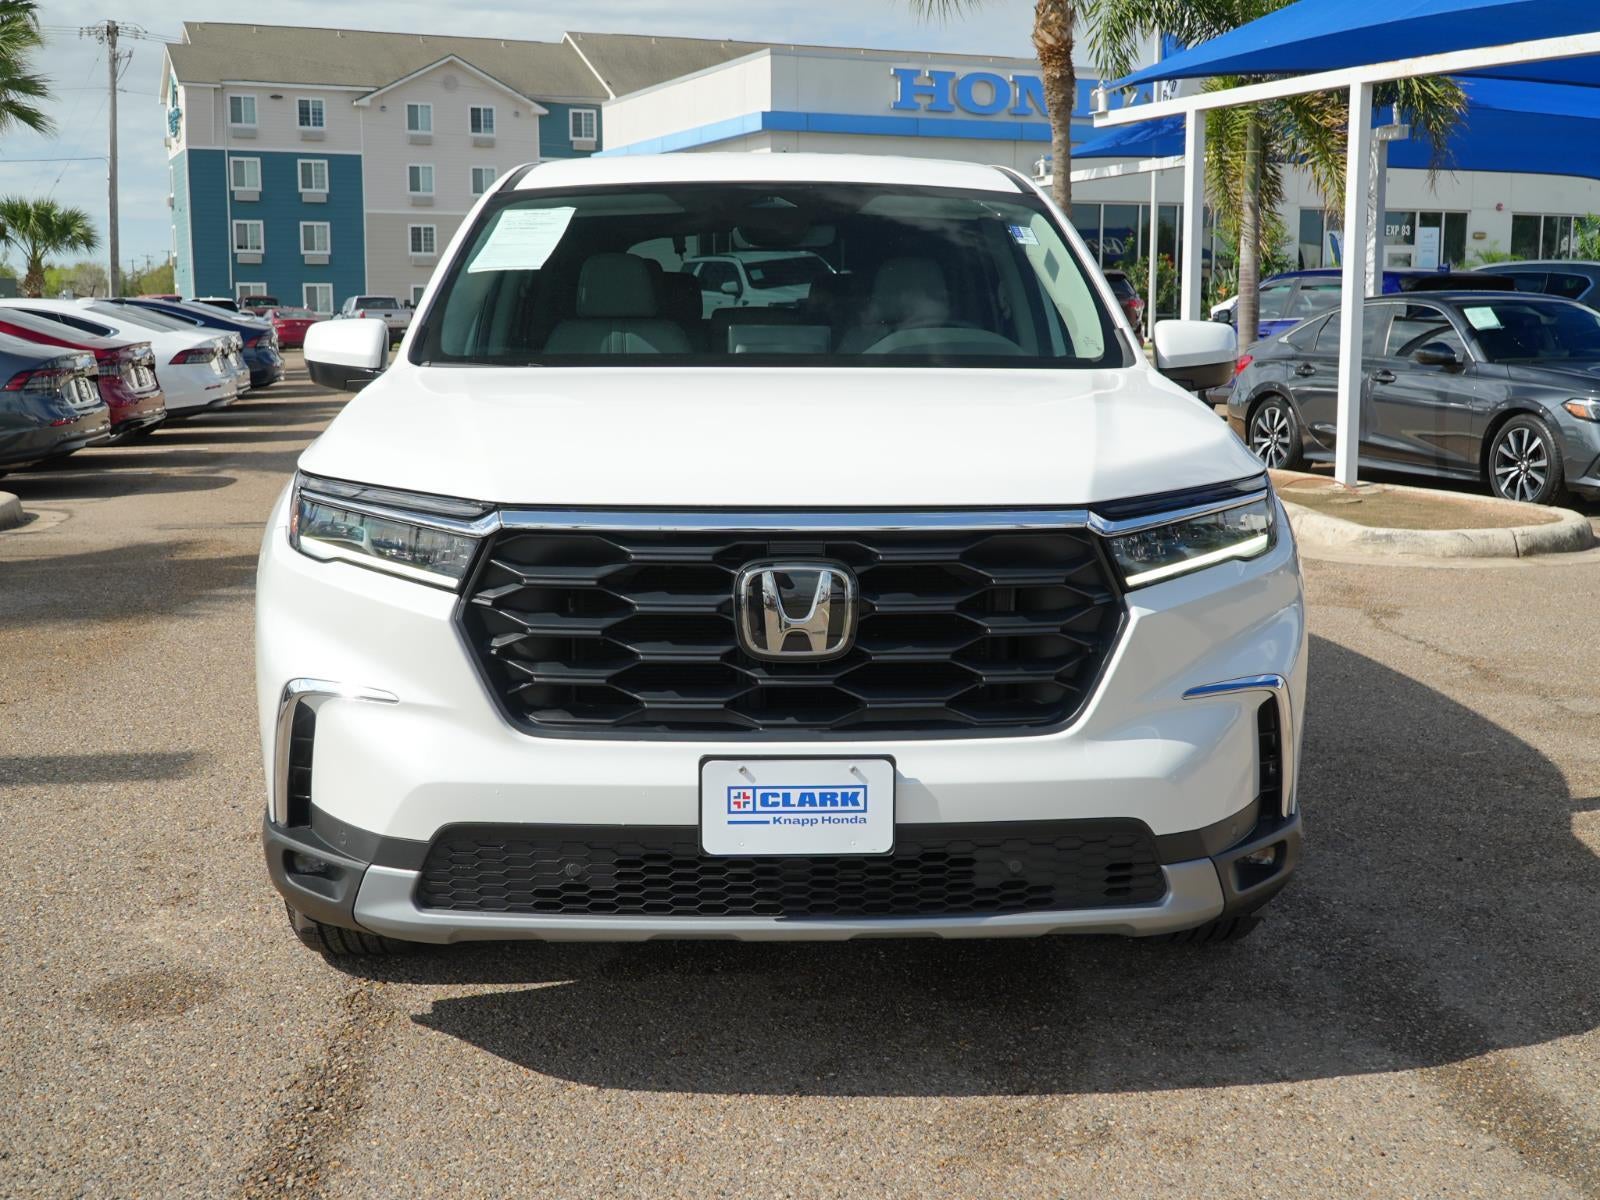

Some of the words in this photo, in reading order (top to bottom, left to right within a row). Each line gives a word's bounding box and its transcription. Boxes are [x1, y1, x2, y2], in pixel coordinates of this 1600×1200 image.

[1386, 225, 1399, 236] EXP
[1401, 225, 1411, 236] 83
[759, 791, 861, 808] CLARK
[772, 816, 819, 827] Knapp
[821, 815, 867, 825] Honda
